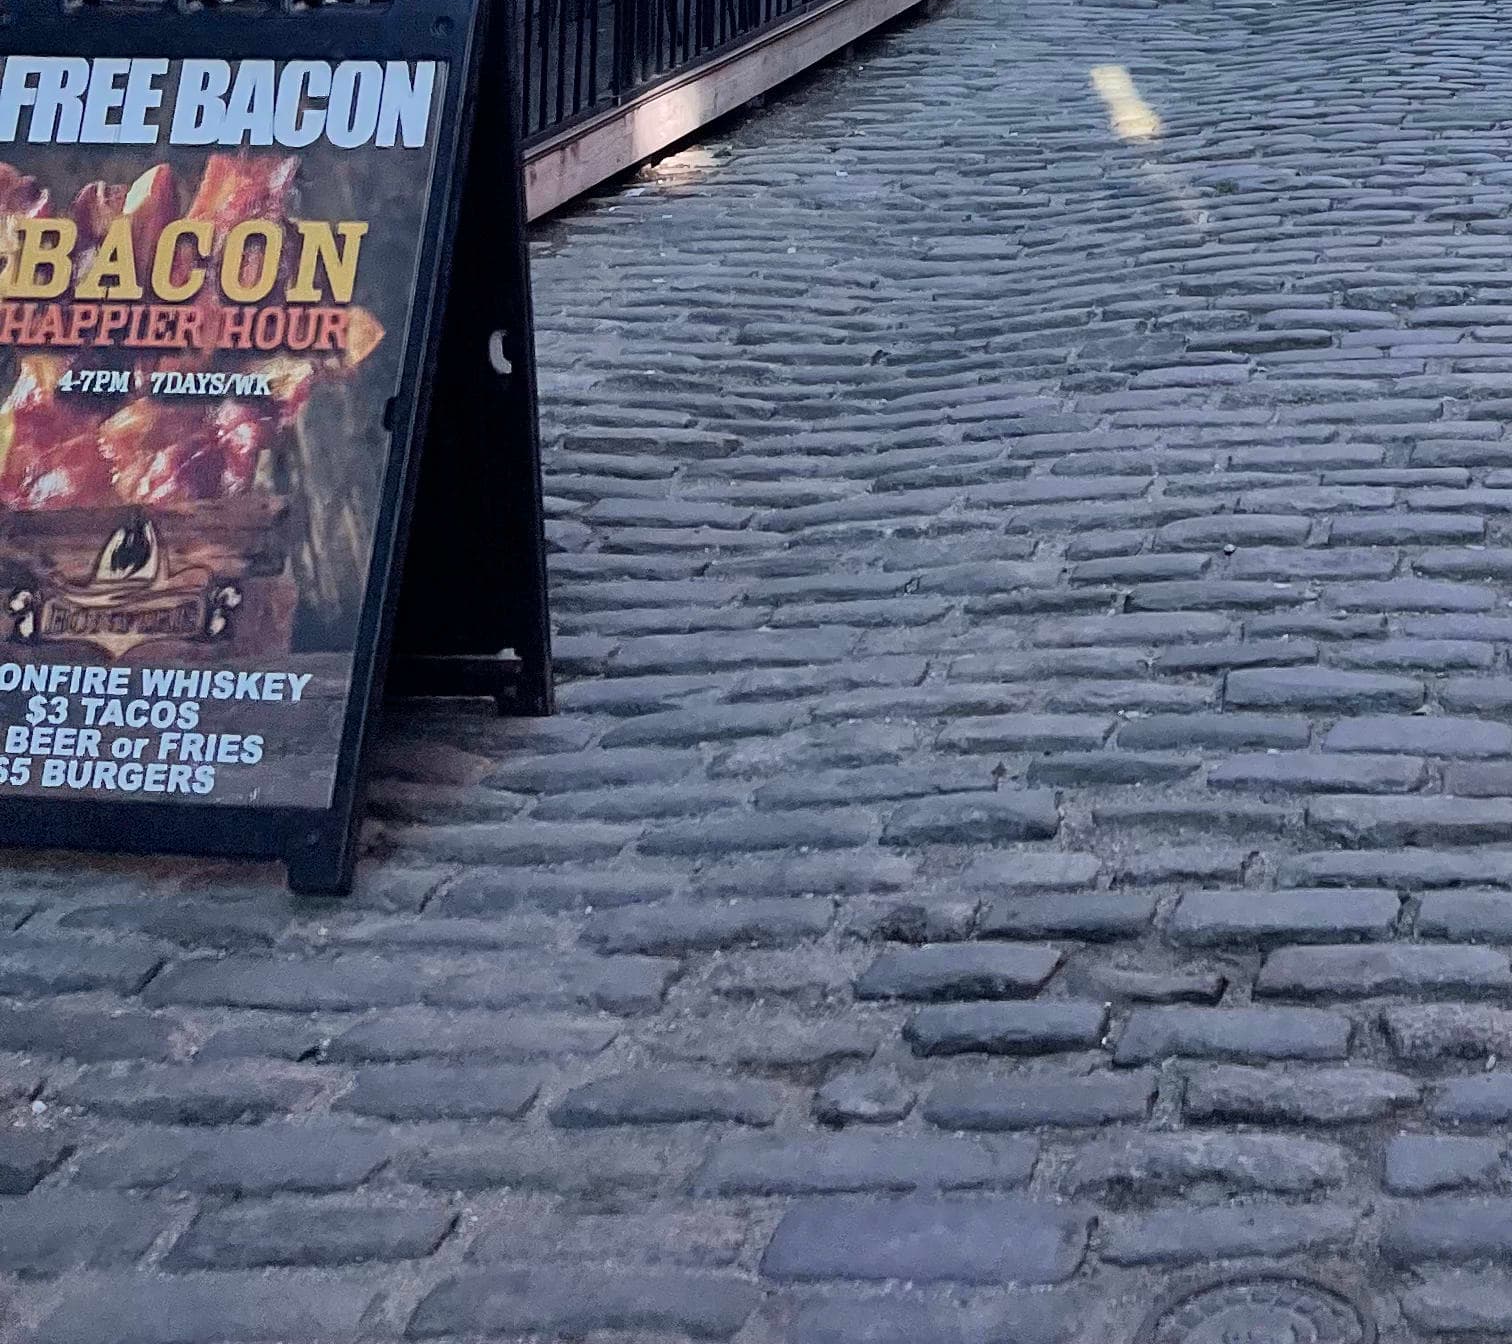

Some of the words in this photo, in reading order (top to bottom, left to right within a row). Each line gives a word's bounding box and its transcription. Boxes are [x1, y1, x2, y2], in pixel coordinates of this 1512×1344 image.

[0, 55, 169, 144] FREE
[169, 59, 437, 148] BACON
[0, 217, 369, 303] BACON
[0, 304, 203, 349] HAPPIER
[217, 306, 348, 350] HOUR
[59, 370, 131, 393] 4-7PM
[151, 371, 272, 396] 7DAYS/WK
[0, 662, 131, 696] ONFIRE
[141, 668, 314, 702] WHISKEY
[25, 695, 69, 726] $3
[81, 697, 201, 730] TACOS
[4, 725, 101, 757] BEER
[111, 737, 149, 759] or
[158, 732, 264, 763] FRIES
[41, 759, 216, 794] BURGERS
